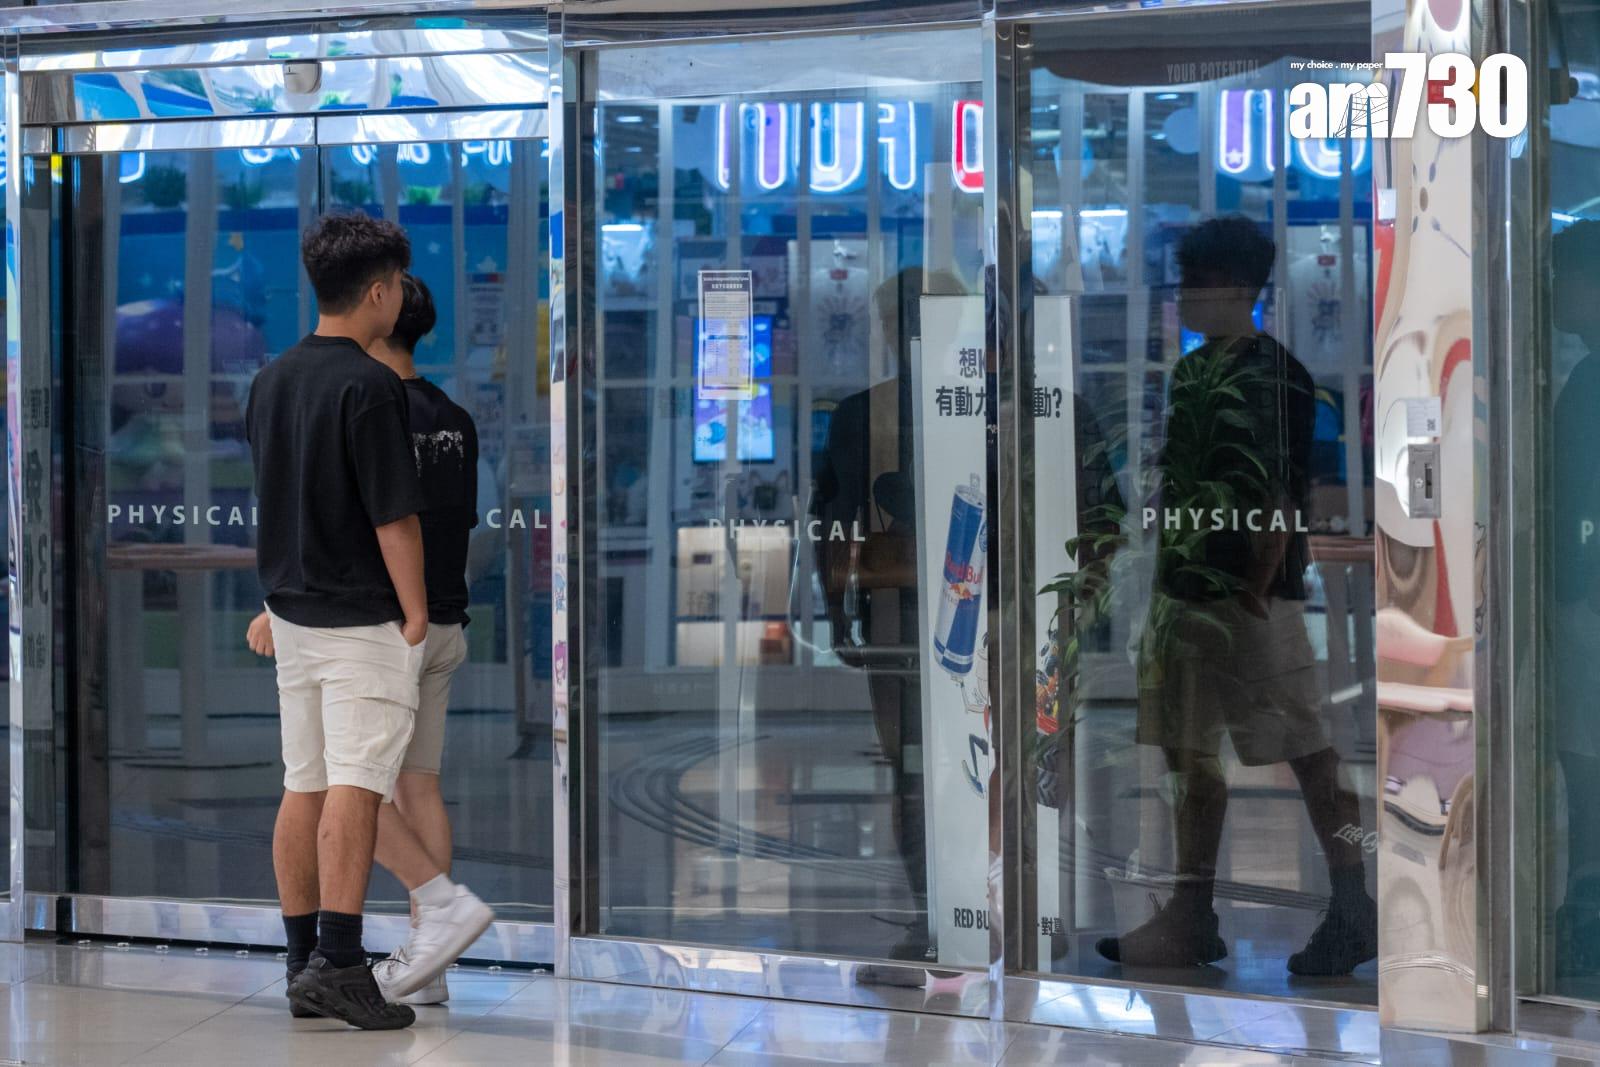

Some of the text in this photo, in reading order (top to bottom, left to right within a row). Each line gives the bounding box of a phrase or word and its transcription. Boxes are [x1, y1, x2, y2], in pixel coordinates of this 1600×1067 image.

[1167, 63, 1196, 83] YOUR
[708, 518, 866, 542] PHYSICAL
[1142, 507, 1309, 532] PHYSICAL
[953, 907, 974, 929] RED
